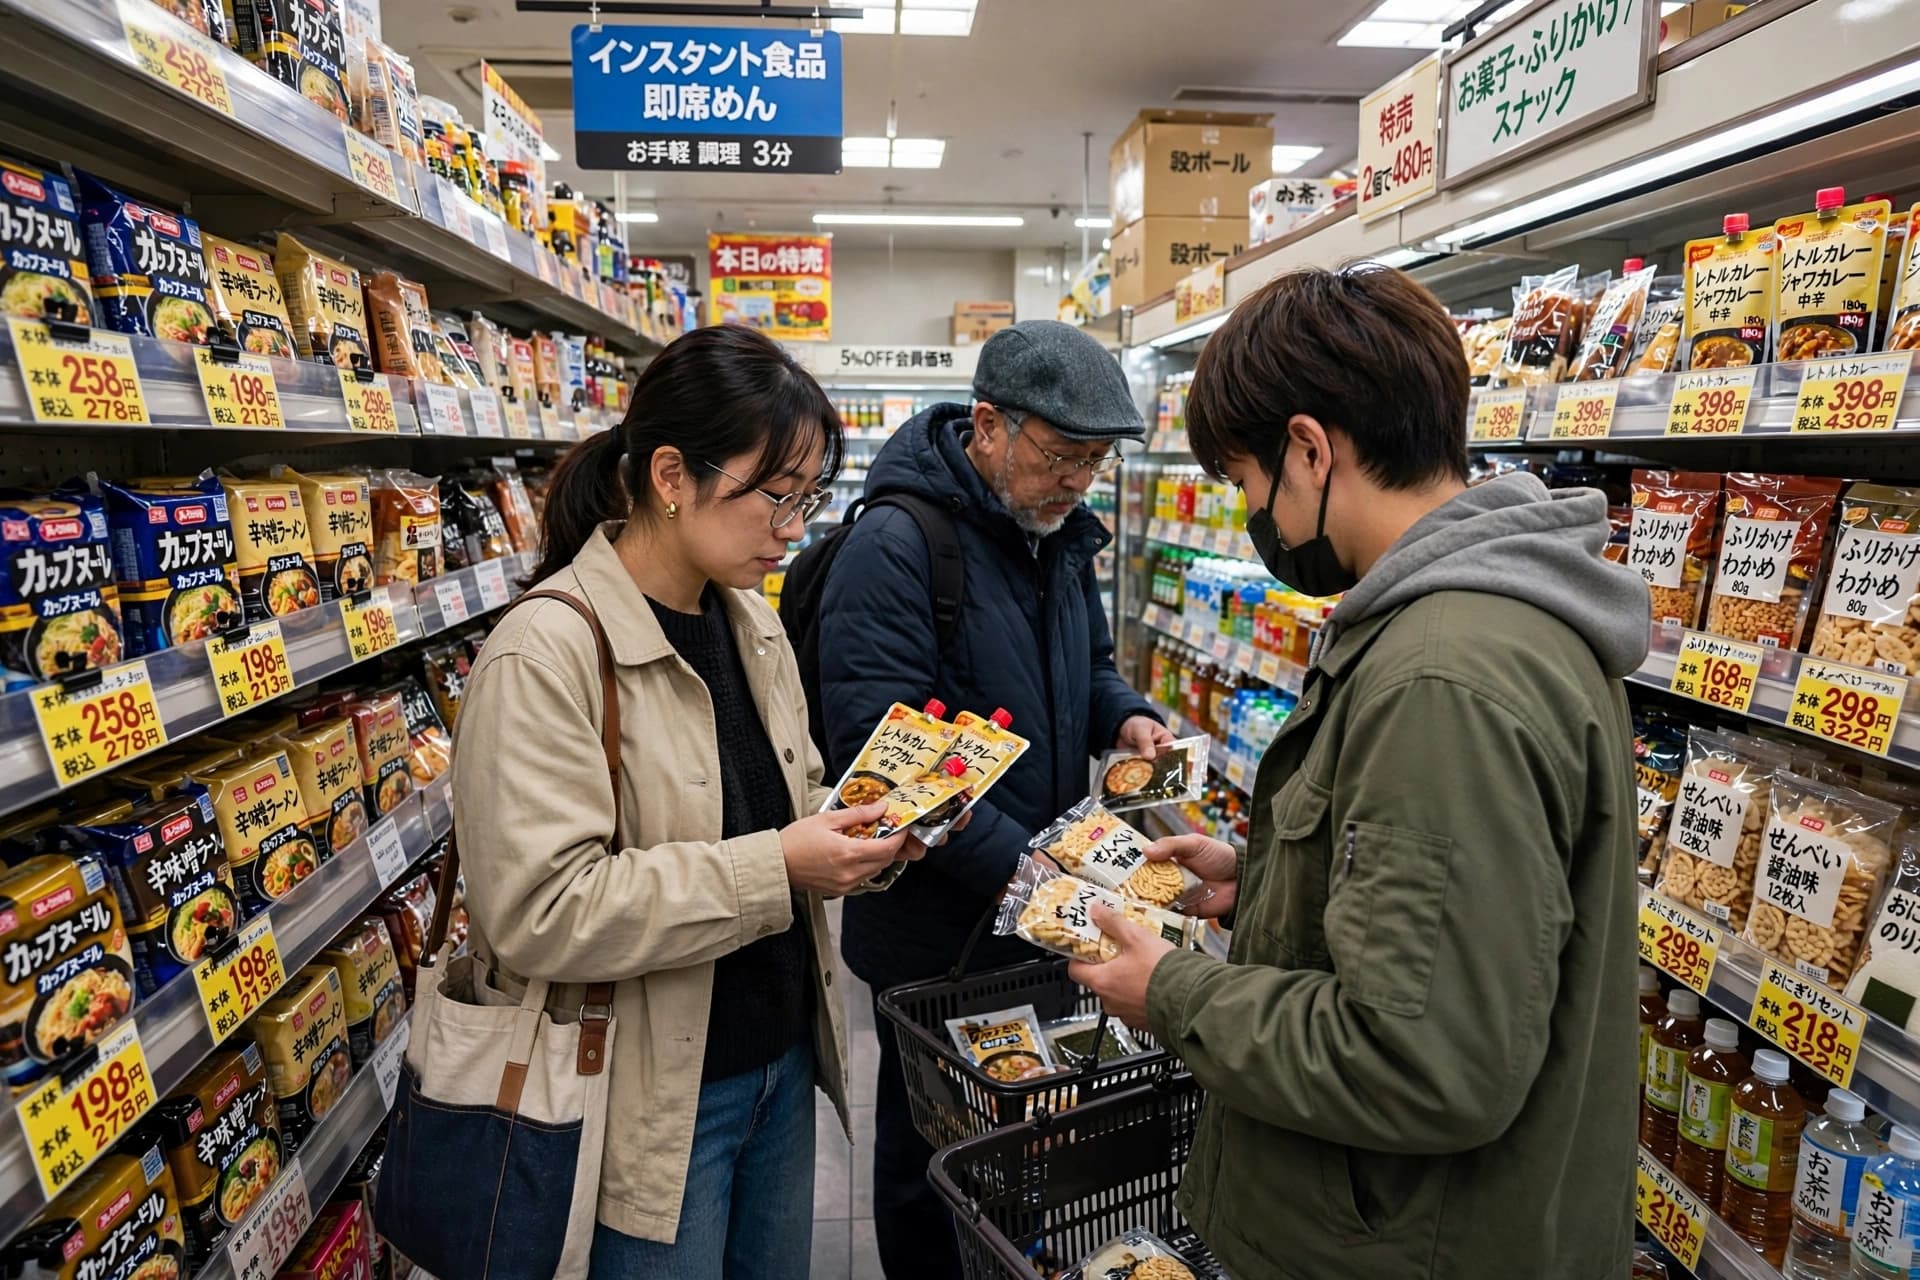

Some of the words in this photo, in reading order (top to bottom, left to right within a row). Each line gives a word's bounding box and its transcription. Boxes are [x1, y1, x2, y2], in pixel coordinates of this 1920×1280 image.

[588, 38, 827, 81] インスタント食品
[643, 82, 778, 122] 即席めん
[1492, 66, 1577, 144] スナック
[1379, 93, 1415, 148] 特売
[627, 139, 692, 166] お手軽
[697, 141, 742, 167] 調理
[752, 139, 793, 168] 3分
[1170, 150, 1251, 174] 段ボール
[1361, 140, 1434, 203] 2個で480円
[716, 245, 824, 273] 本日の特売
[1782, 243, 1872, 270] レトルカレー
[1695, 264, 1769, 289] レトルカレー
[1781, 268, 1866, 294] ジャワカレー
[1694, 286, 1763, 309] ジャワカレー
[1798, 291, 1825, 309] 中辛
[1709, 307, 1732, 323] 中辛
[1743, 315, 1765, 327] 180g
[30, 368, 61, 388] 本体
[62, 354, 139, 398] 258円
[841, 349, 953, 369] 5%OFF会員価格
[1806, 363, 1880, 381] レトルトカレー
[206, 384, 227, 400] 本体
[229, 372, 277, 408] 198円
[1673, 403, 1691, 415] 本体
[1693, 390, 1745, 418] 398円
[1800, 396, 1824, 410] 本体
[1827, 379, 1897, 412] 398円
[40, 396, 75, 418] 税込
[83, 398, 143, 422] 278円
[214, 406, 236, 424] 税込
[240, 407, 279, 427] 213円
[1573, 399, 1611, 422] 398円
[1670, 421, 1689, 433] 税込
[1691, 417, 1738, 434] 430円
[1797, 416, 1821, 431] 税込
[1824, 411, 1888, 431] 430円
[1571, 423, 1606, 438] 430円
[1633, 518, 1689, 543] ふりかけ
[1725, 525, 1793, 553] ふりかけ
[1632, 543, 1676, 568] わかめ
[1722, 552, 1776, 580] わかめ
[1841, 538, 1920, 570] ふりかけ
[1731, 580, 1749, 596] 80g
[1836, 570, 1900, 600] わかめ
[362, 608, 393, 636] 198円
[1846, 599, 1867, 616] 80g
[1686, 637, 1731, 656] ふりかけ
[219, 670, 240, 688] 本体
[240, 644, 287, 682] 198円
[1679, 662, 1698, 676] 本体
[1703, 657, 1752, 693] 168円
[226, 691, 248, 712] 税込
[250, 674, 289, 702] 213円
[1675, 679, 1694, 695] 税込
[1699, 684, 1745, 710] 182円
[1796, 693, 1821, 708] 本体
[1820, 687, 1892, 732] 298円
[51, 727, 83, 752] 本体
[81, 691, 157, 743] 258円
[1792, 712, 1816, 730] 税込
[1821, 719, 1884, 752] 322円
[62, 752, 96, 779] 税込
[103, 727, 160, 763] 278円
[878, 758, 898, 773] 中辛
[1683, 782, 1742, 816] せんべい
[1679, 806, 1723, 840] 醤油味
[1092, 829, 1133, 863] せんべい
[1679, 831, 1711, 857] 12枚入
[1769, 827, 1842, 870] せんべい
[1766, 854, 1820, 895] 醤油味
[1768, 882, 1806, 913] 12枚入
[1647, 897, 1714, 944] おにぎりセット
[4, 901, 111, 983] カップヌードル
[1656, 925, 1710, 975] 298円
[38, 945, 103, 993] カップヌードル
[208, 990, 230, 1014] 本体
[228, 945, 277, 996] 198円
[1658, 951, 1703, 991] 322円
[215, 1010, 239, 1036] 税込
[240, 970, 282, 1016] 213円
[1769, 969, 1853, 1026] おにぎりセット
[1759, 996, 1782, 1018] 本体
[1782, 1001, 1852, 1065] 218円
[1756, 1015, 1778, 1041] 税込
[1785, 1033, 1844, 1083] 322円
[27, 1087, 58, 1119] 本体
[39, 1124, 72, 1161] 本体
[70, 1061, 145, 1132] 198円
[49, 1148, 85, 1186] 税込
[91, 1089, 150, 1151] 278円
[1637, 1155, 1700, 1218] おにぎりセット
[1803, 1151, 1832, 1201] お茶
[261, 1192, 306, 1254] 198円
[1649, 1188, 1698, 1251] 218円
[1864, 1190, 1895, 1245] お茶
[1648, 1215, 1692, 1266] 235円
